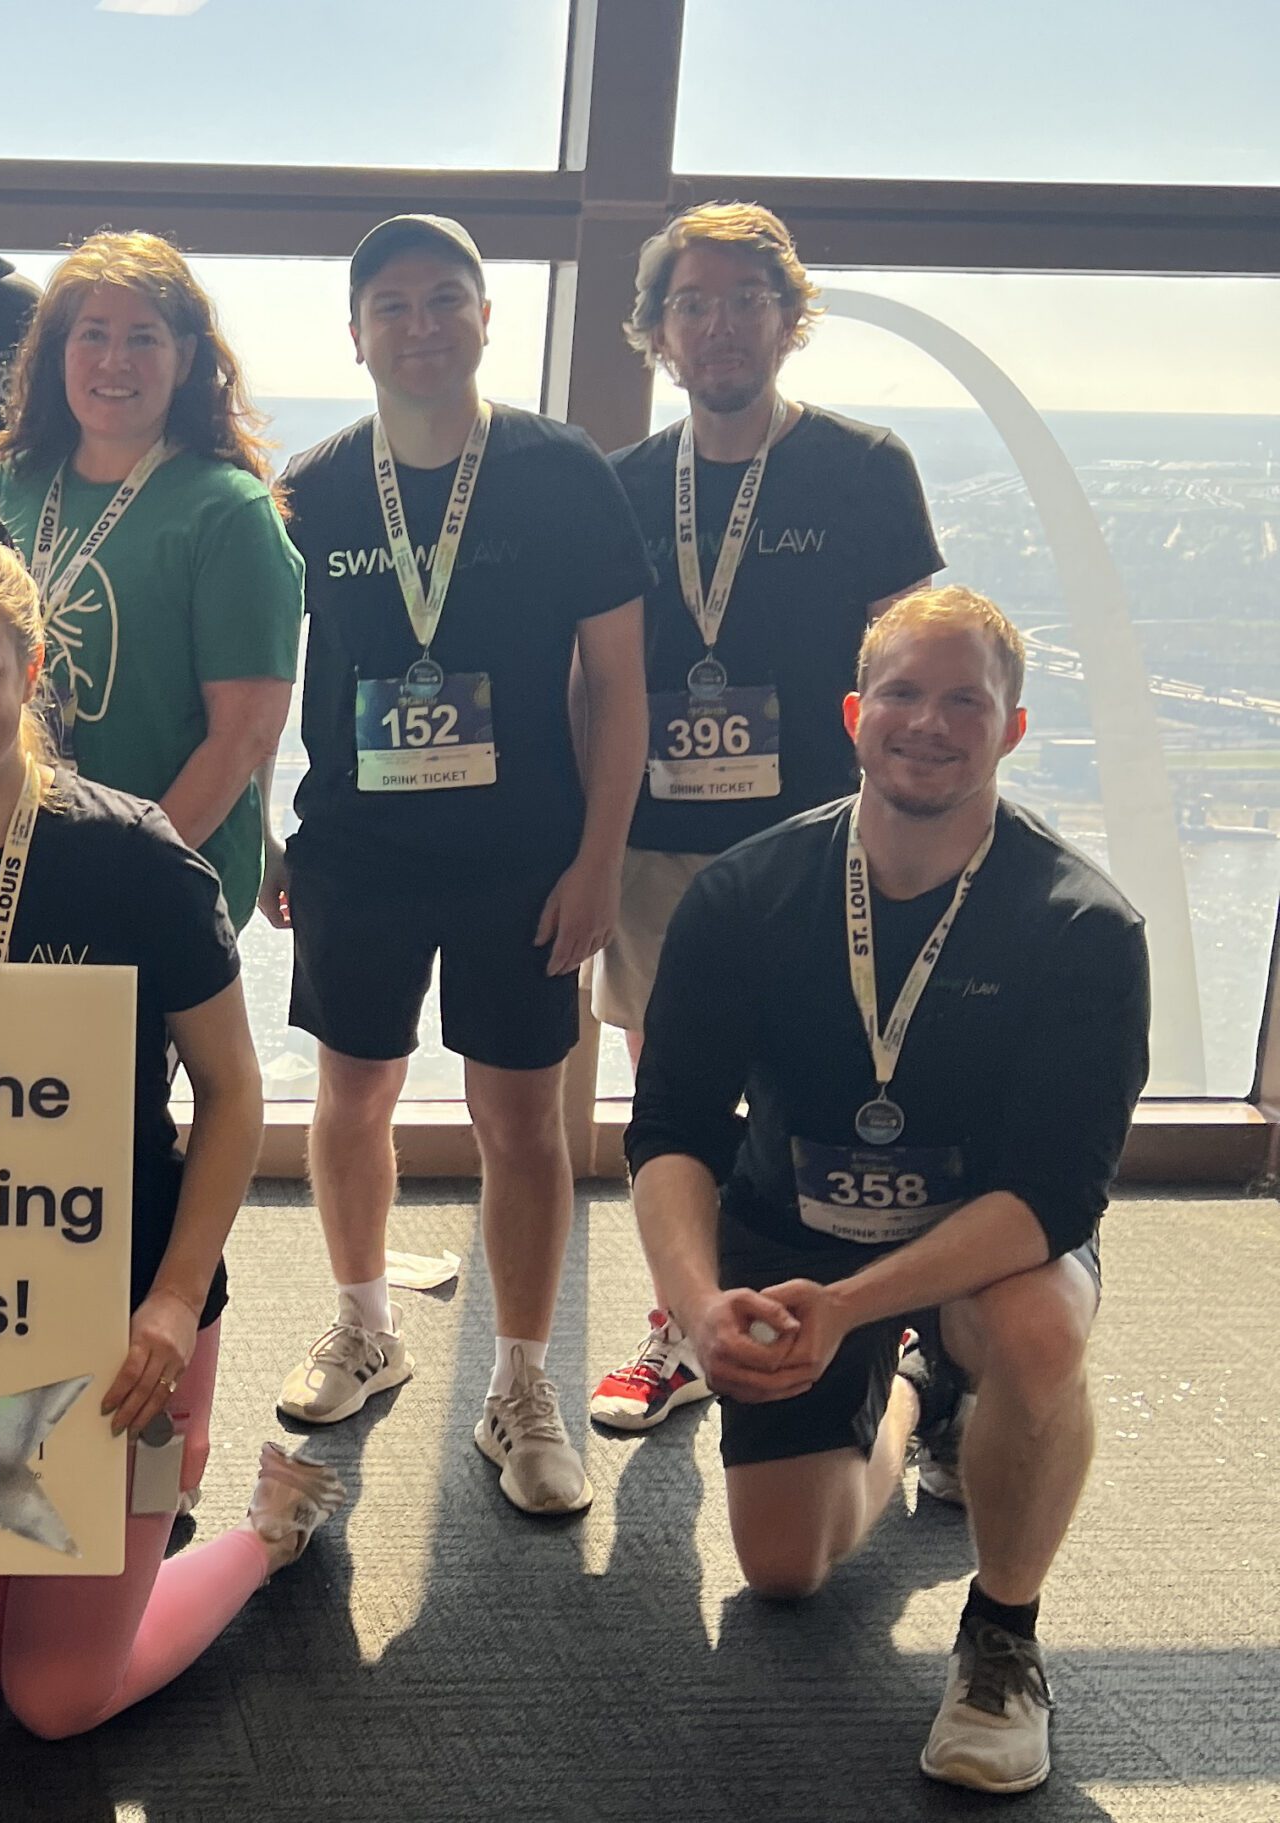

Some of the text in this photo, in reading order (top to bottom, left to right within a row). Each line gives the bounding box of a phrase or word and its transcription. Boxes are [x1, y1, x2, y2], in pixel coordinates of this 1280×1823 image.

[81, 486, 135, 556] ST. LOUIS
[378, 459, 403, 540] ST. LOUIS
[446, 509, 464, 535] ST.
[455, 453, 478, 504] LOUIS
[680, 467, 692, 543] ST. LOUIS
[730, 458, 761, 539] ST. LOUIS
[39, 506, 56, 553] LOUIS
[381, 704, 460, 748] 152
[666, 714, 751, 758] 396
[382, 770, 468, 786] DRINK TICKET
[670, 781, 754, 795] DRINK TICKET
[850, 858, 869, 957] ST. LOUIS
[826, 1170, 928, 1208] 358
